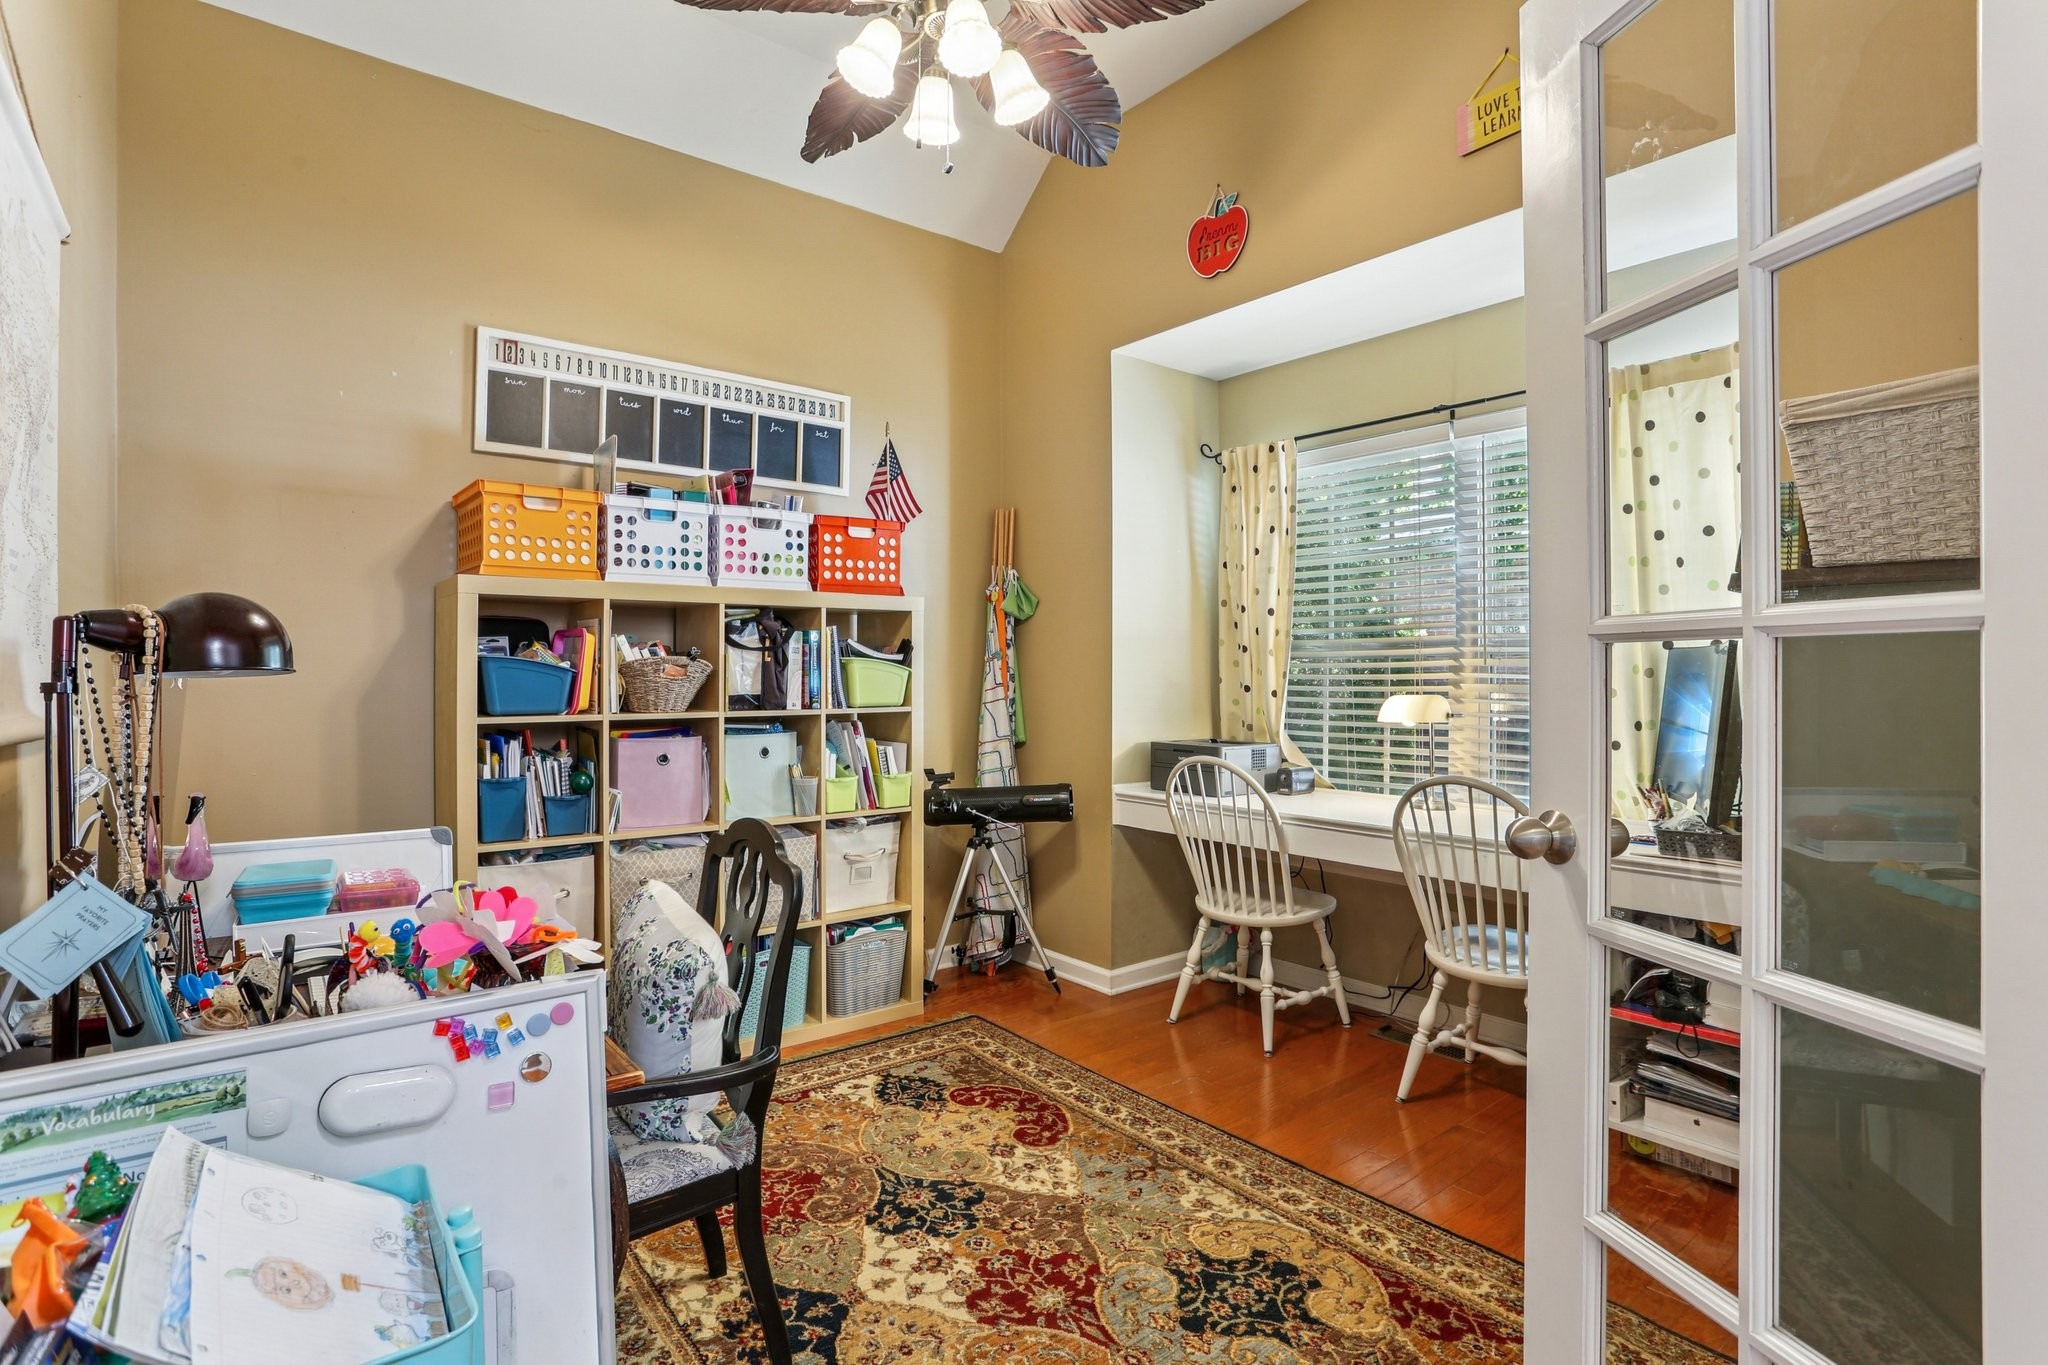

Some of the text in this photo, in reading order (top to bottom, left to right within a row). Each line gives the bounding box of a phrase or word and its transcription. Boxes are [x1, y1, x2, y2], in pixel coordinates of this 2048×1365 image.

[1477, 93, 1509, 120] LOVE
[1197, 232, 1239, 263] BIG
[495, 343, 836, 418] 1 2 3 4 5 6 7 8 9 10 11 12 13 14 15 16 17 18 19 20 21 22 23 24 25 26 27 28 29 30 31
[504, 376, 527, 386] sun
[563, 386, 586, 396] mon
[618, 396, 641, 409] tues
[673, 407, 692, 417] wed
[722, 413, 744, 425] thur
[769, 421, 785, 433] fri
[815, 430, 830, 439] sat
[81, 905, 109, 926] FAVORITE
[97, 905, 108, 914] MY
[75, 912, 101, 931] PRAYERS
[41, 1103, 156, 1137] Vocabulary
